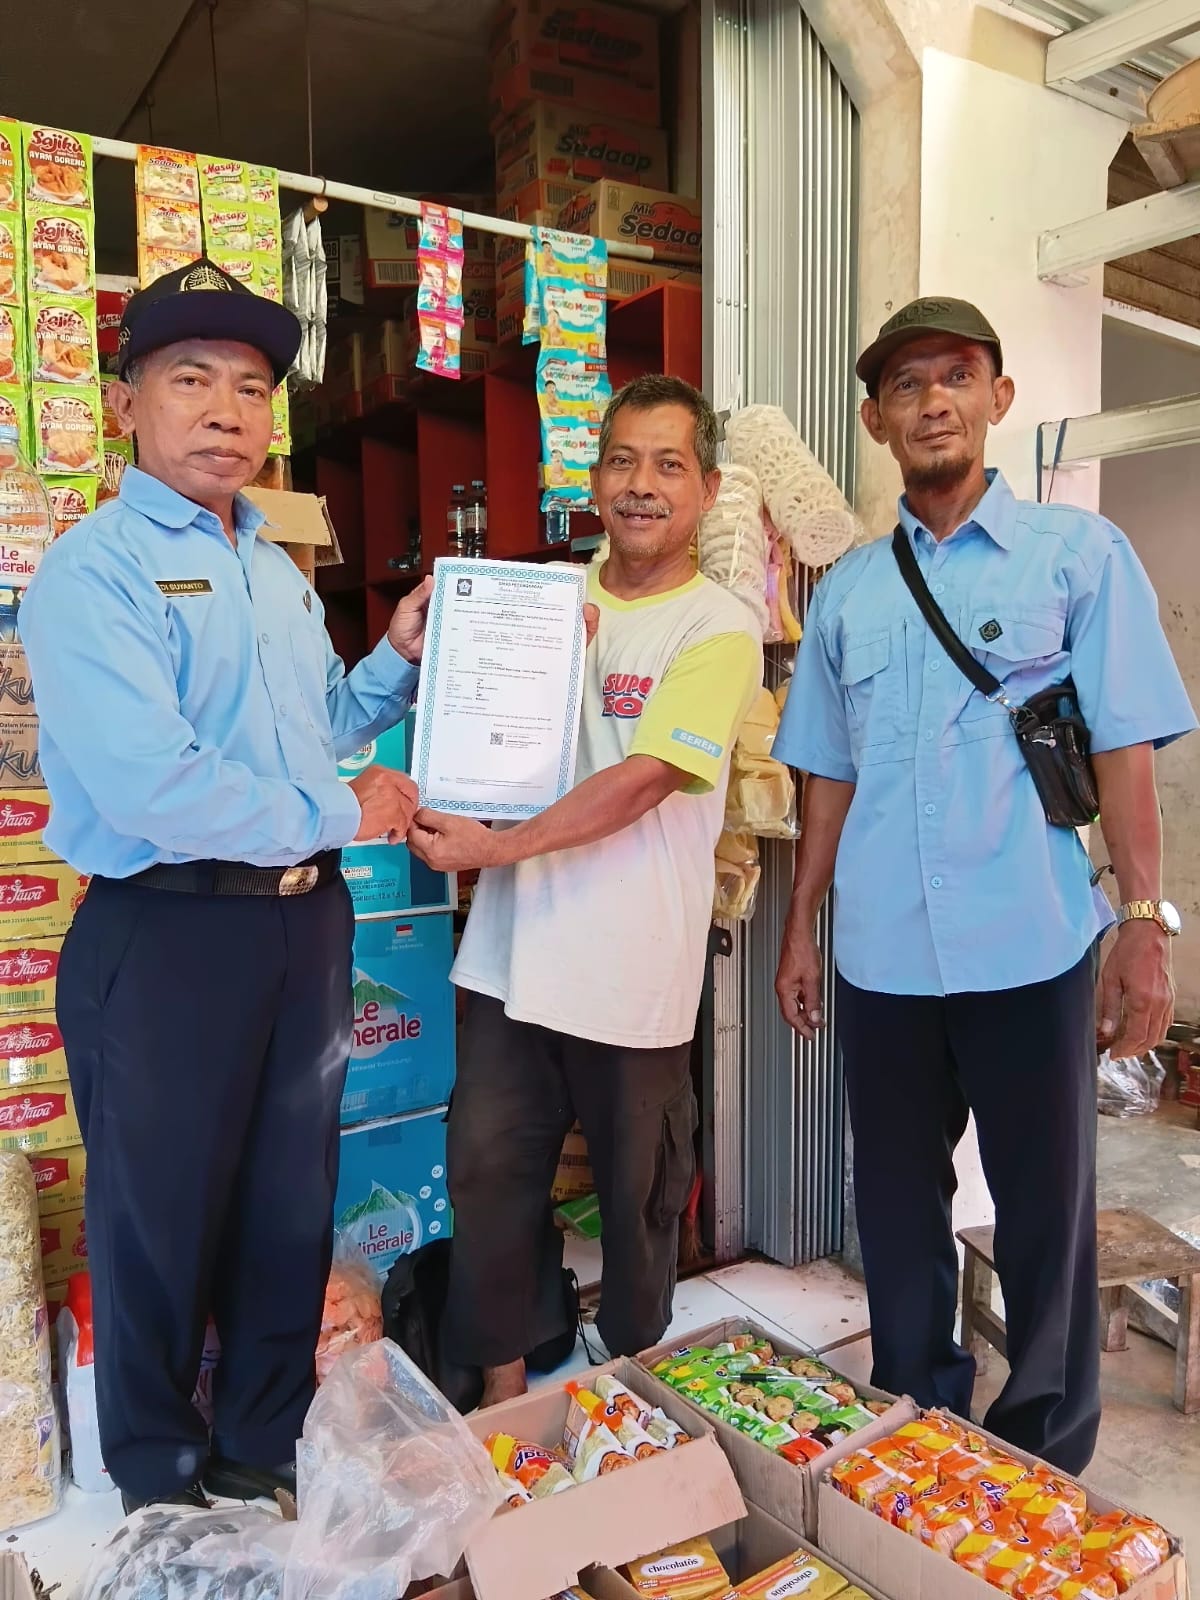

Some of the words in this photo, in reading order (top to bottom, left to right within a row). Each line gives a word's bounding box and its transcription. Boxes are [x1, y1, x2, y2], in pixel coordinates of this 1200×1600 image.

[32, 130, 83, 154] Sajiku
[29, 151, 52, 162] AYAM
[54, 155, 86, 168] GORENG
[556, 135, 653, 172] Sedaap
[206, 162, 241, 175] Masako
[618, 213, 702, 246] Sedaa
[57, 245, 89, 256] GORENG
[65, 423, 97, 433] GORENG
[1, 545, 19, 560] Le
[0, 560, 36, 574] erale
[169, 582, 205, 591] SUYANTO
[678, 731, 717, 754] SEREH
[353, 1001, 380, 1024] e
[368, 1223, 388, 1241] Le
